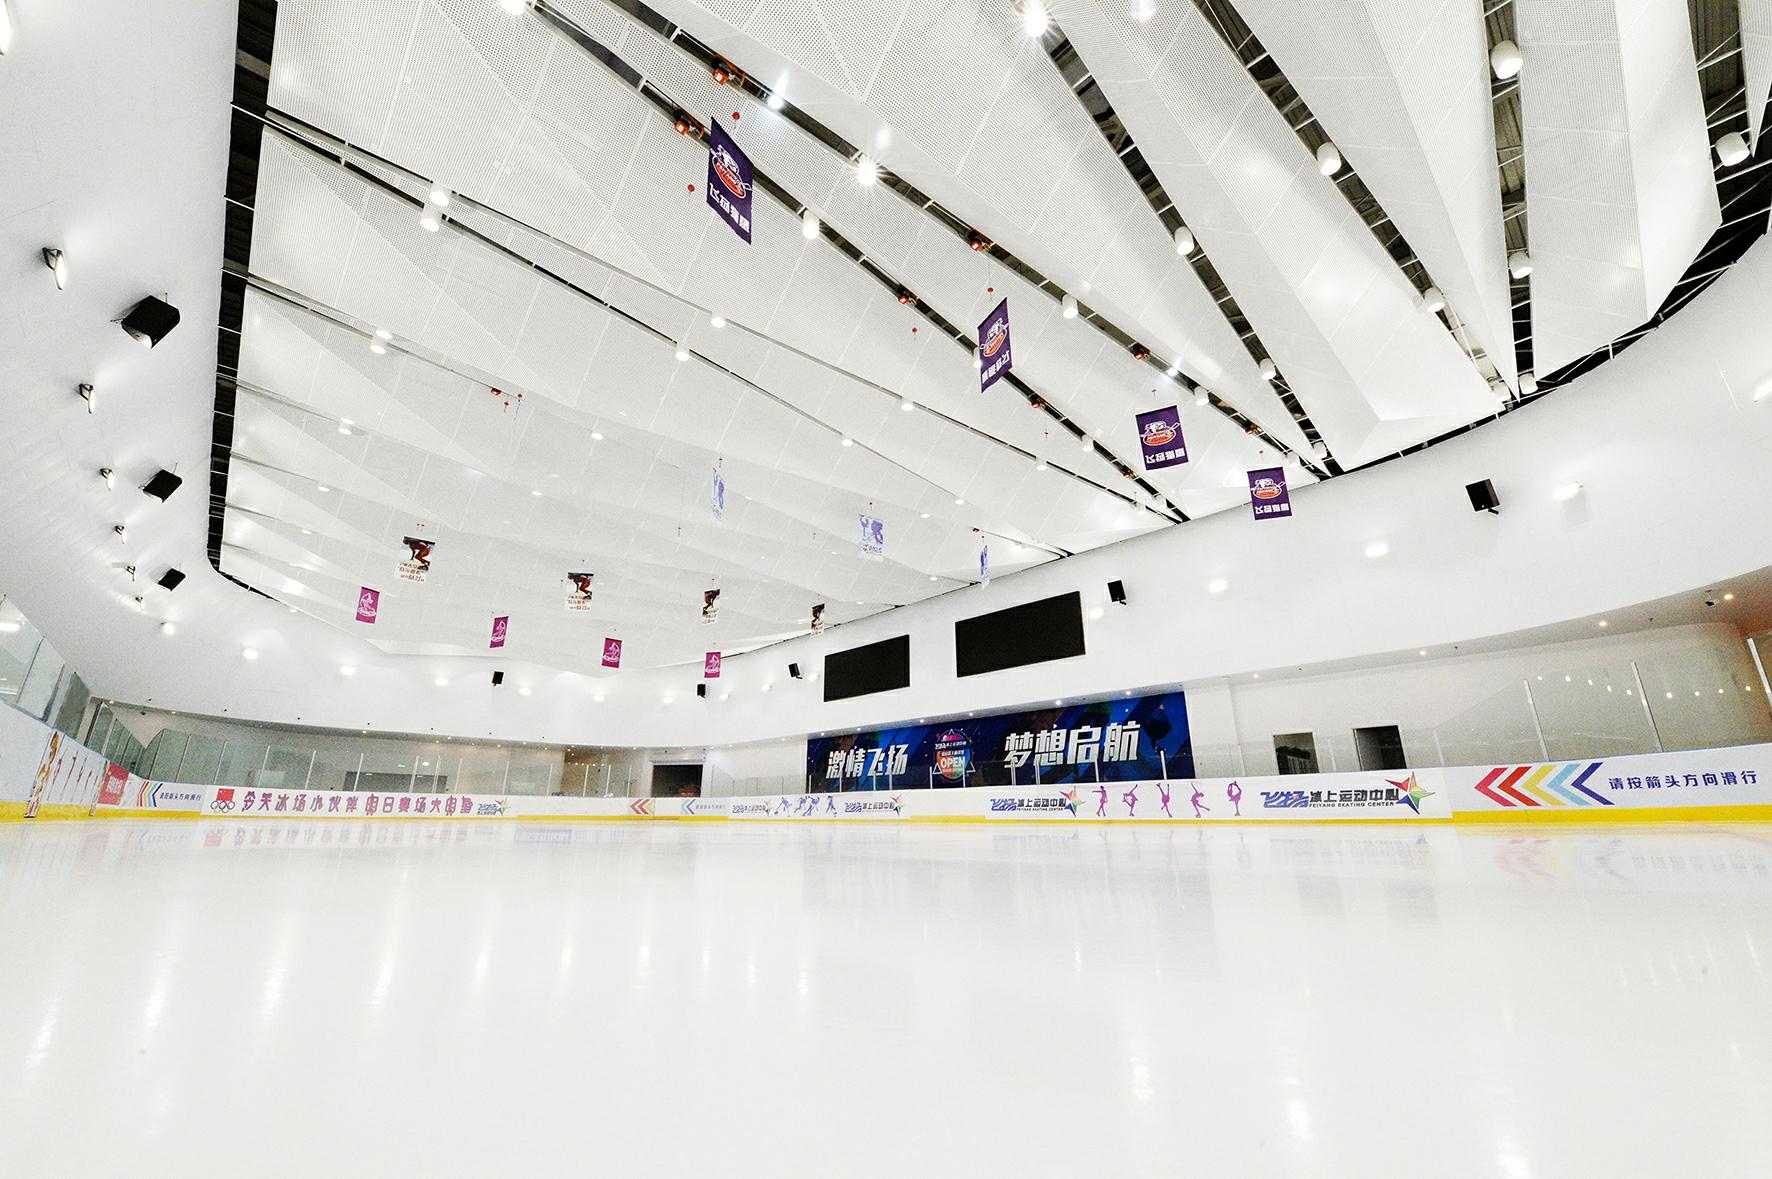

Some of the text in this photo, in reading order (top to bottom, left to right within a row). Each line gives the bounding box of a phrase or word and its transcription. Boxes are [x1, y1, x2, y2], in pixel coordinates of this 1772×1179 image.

[1004, 721, 1140, 768] 梦想启航
[826, 745, 909, 779] 激情飞扬
[940, 756, 965, 769] OPEN
[1608, 770, 1758, 791] 请按箭头方向滑行
